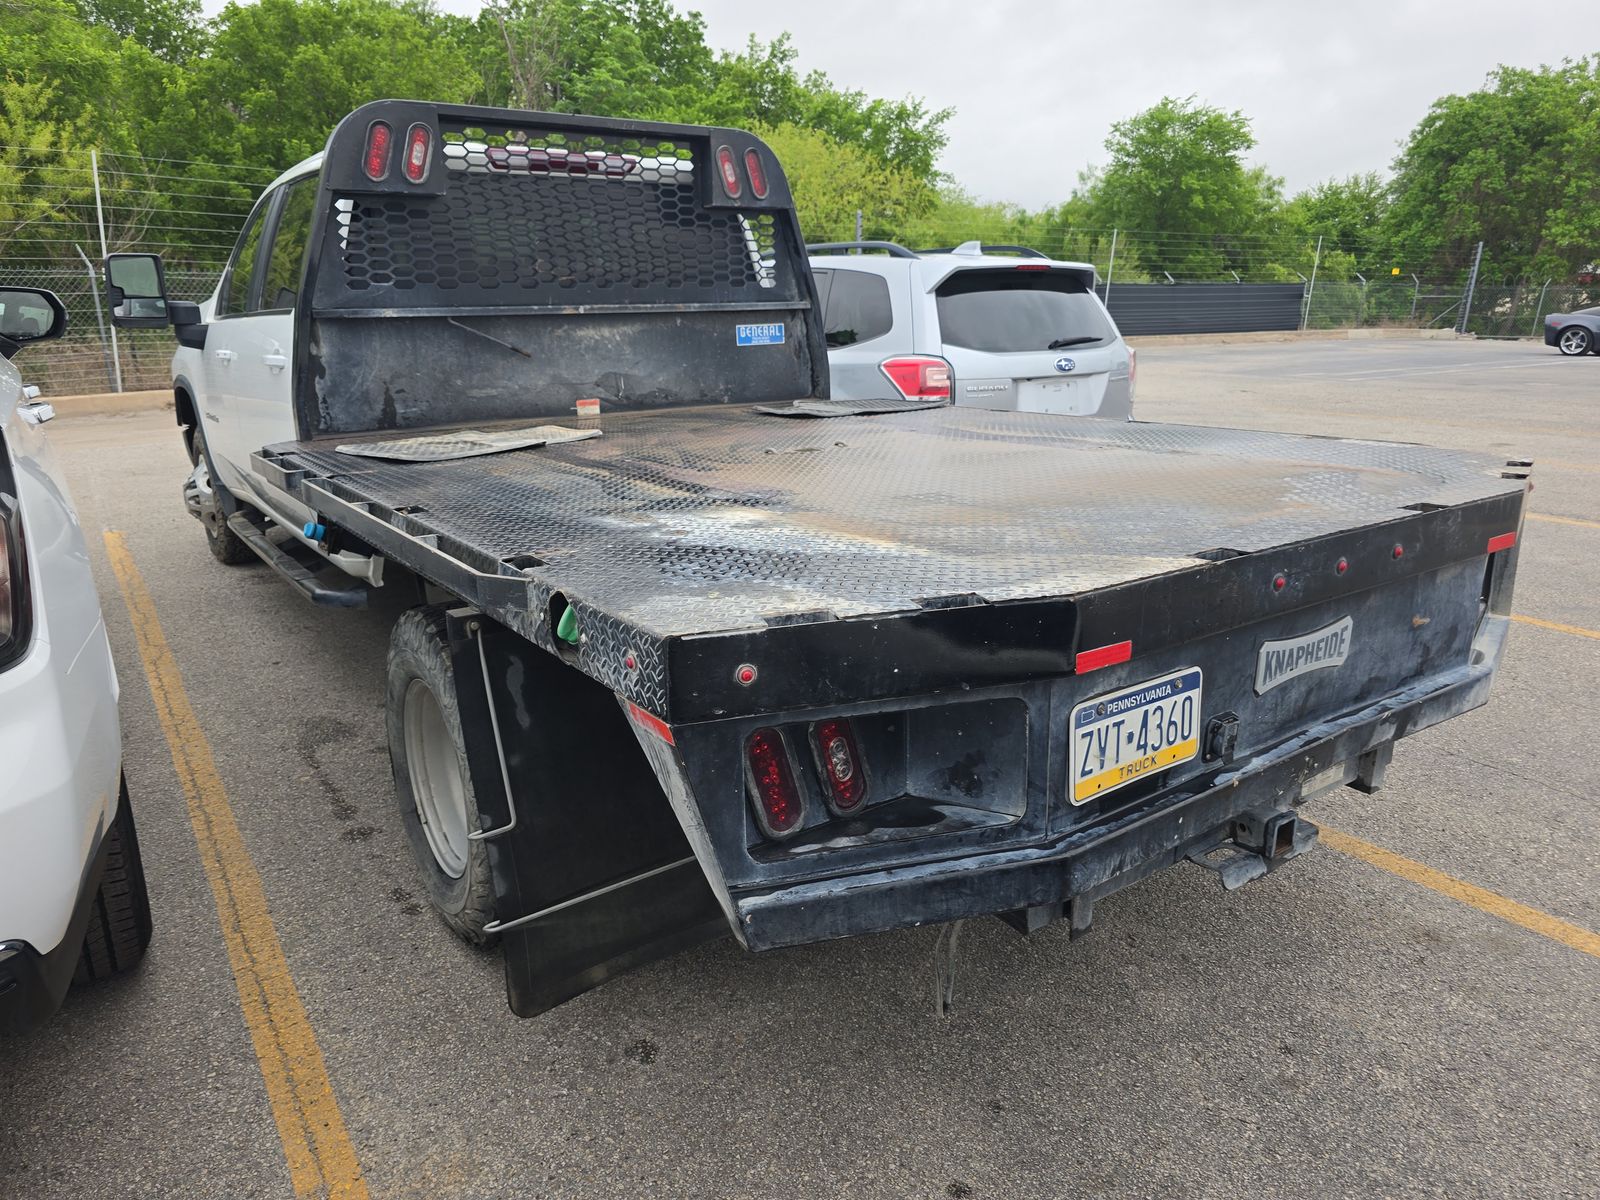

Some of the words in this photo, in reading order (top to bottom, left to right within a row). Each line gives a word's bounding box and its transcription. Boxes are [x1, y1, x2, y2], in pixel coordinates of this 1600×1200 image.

[740, 326, 781, 337] GENERAL
[1262, 625, 1349, 687] KNAPHEIDE
[1106, 685, 1172, 714] PENNSYLVANIA
[1119, 755, 1158, 779] TRUCK
